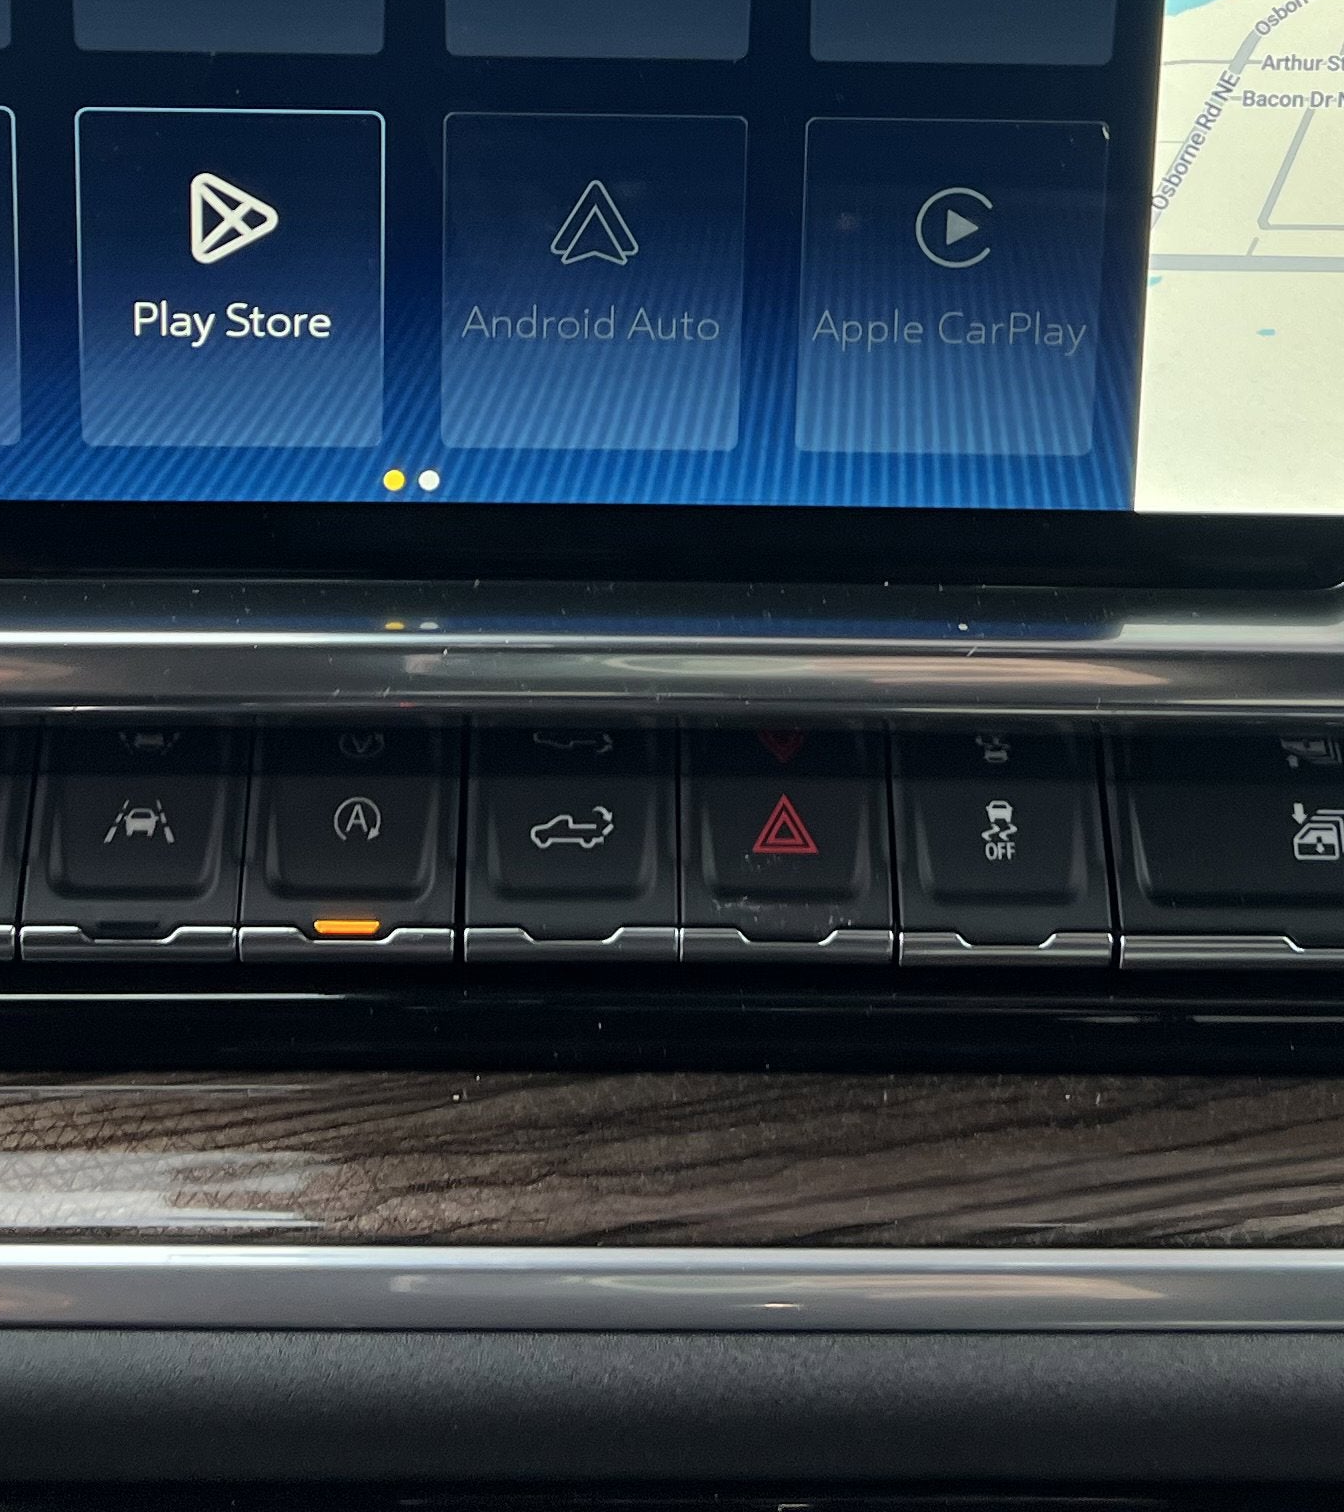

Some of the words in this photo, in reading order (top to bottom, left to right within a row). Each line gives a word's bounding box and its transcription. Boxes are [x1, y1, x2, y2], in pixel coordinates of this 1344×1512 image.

[1261, 54, 1322, 71] Arthur
[1242, 90, 1304, 108] Bacon
[1310, 91, 1334, 108] Dr
[1152, 131, 1207, 210] Osborne
[1195, 101, 1223, 131] Rd
[1211, 69, 1241, 102] NE
[133, 301, 216, 347] Play
[226, 303, 332, 338] Store
[461, 306, 617, 342] Android
[626, 307, 721, 342] Auto
[812, 309, 924, 353] Apple
[938, 310, 1089, 356] CarPlay
[984, 842, 1016, 861] OFF
